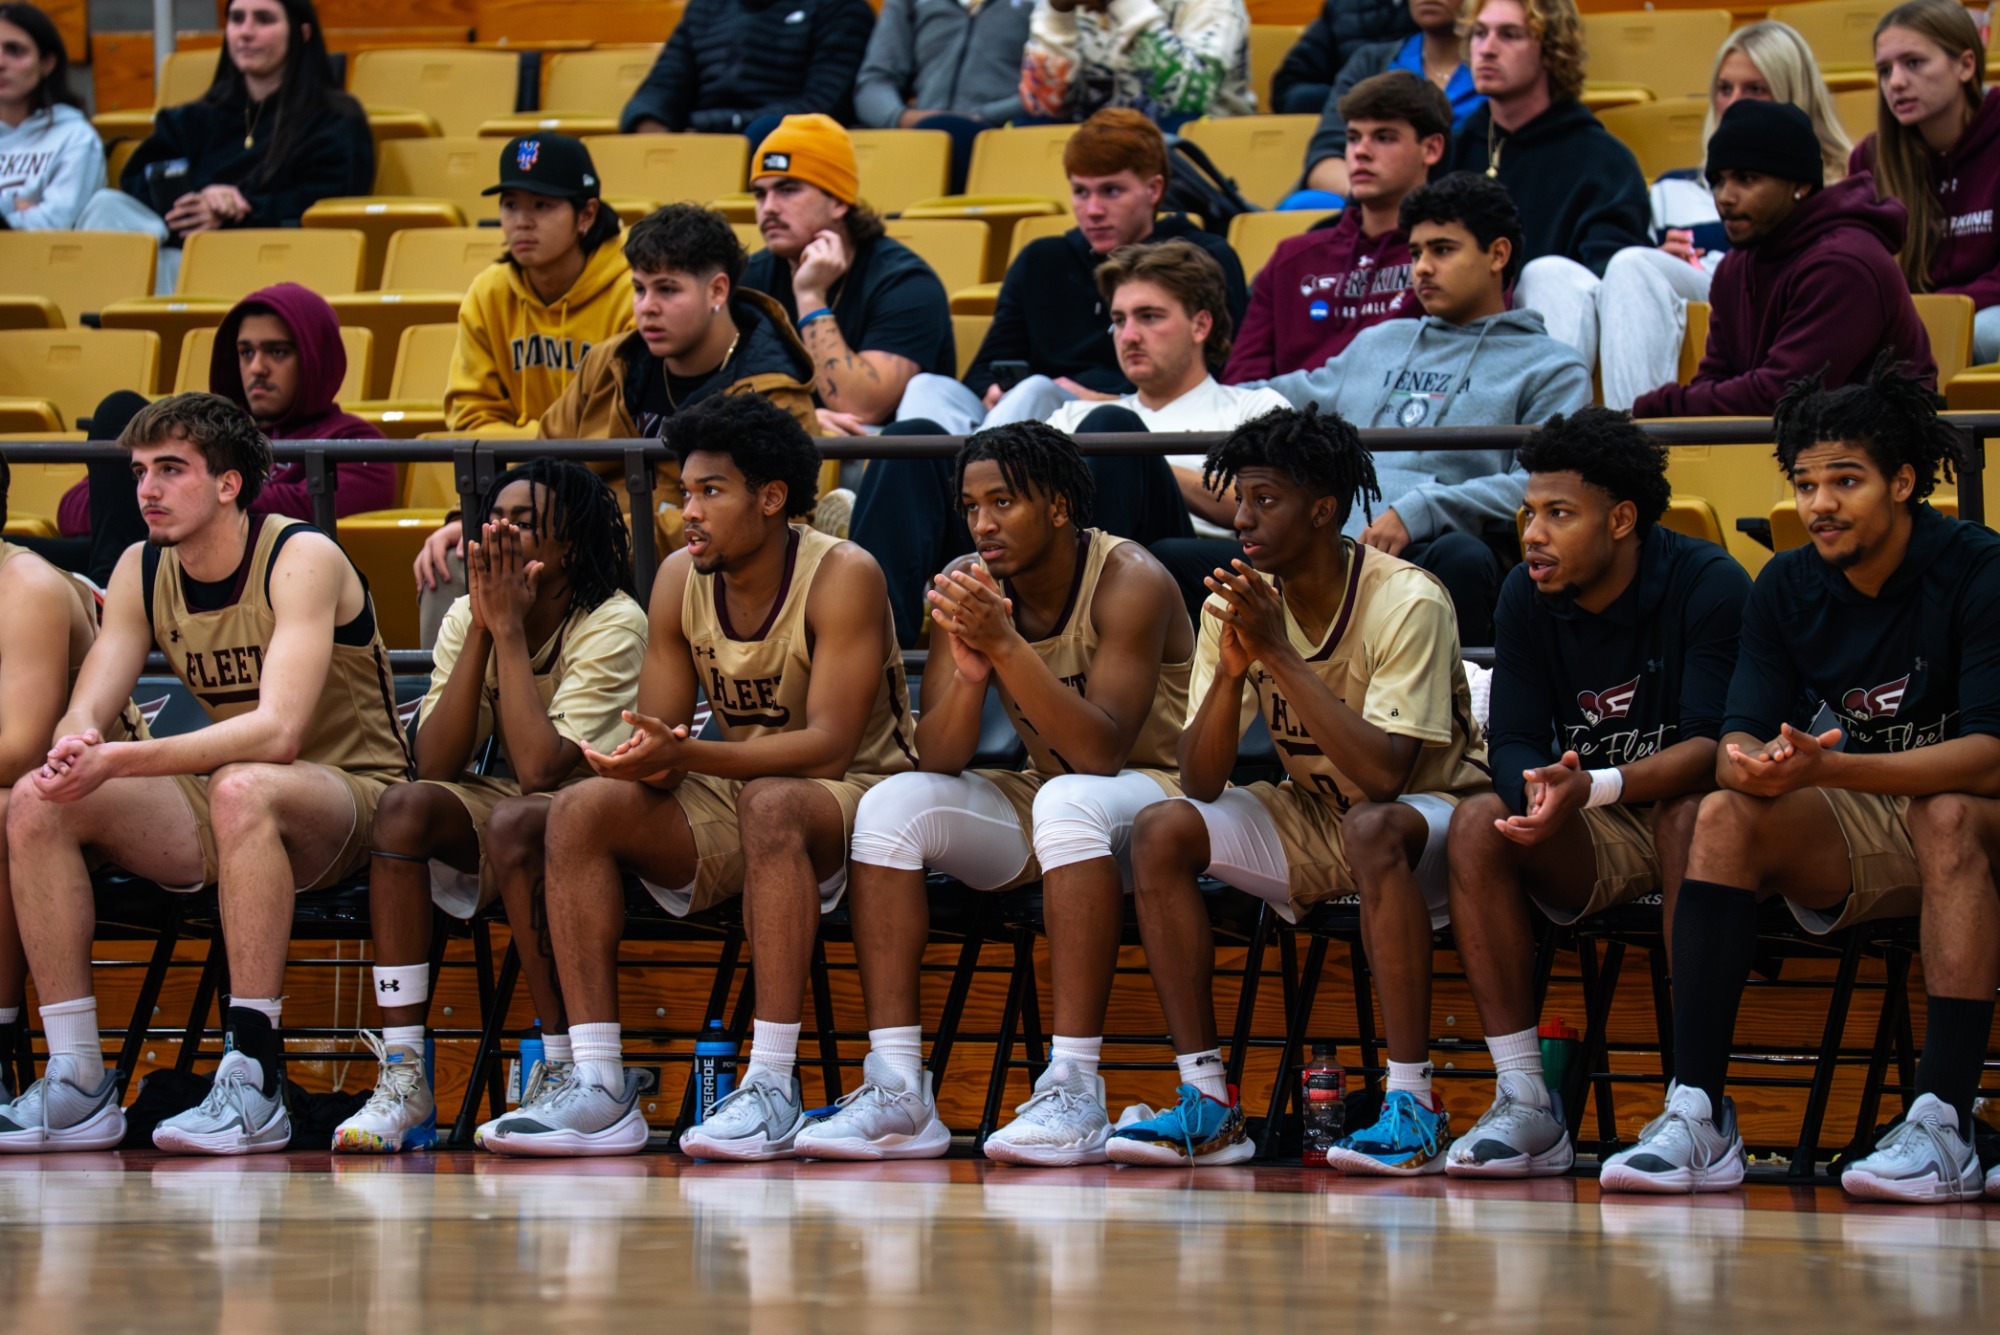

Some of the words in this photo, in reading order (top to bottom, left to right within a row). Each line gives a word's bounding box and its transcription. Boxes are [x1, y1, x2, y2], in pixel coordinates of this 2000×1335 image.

[186, 645, 263, 688] FLEET
[1600, 723, 1678, 765] Fleet
[1876, 709, 1960, 753] Fleet
